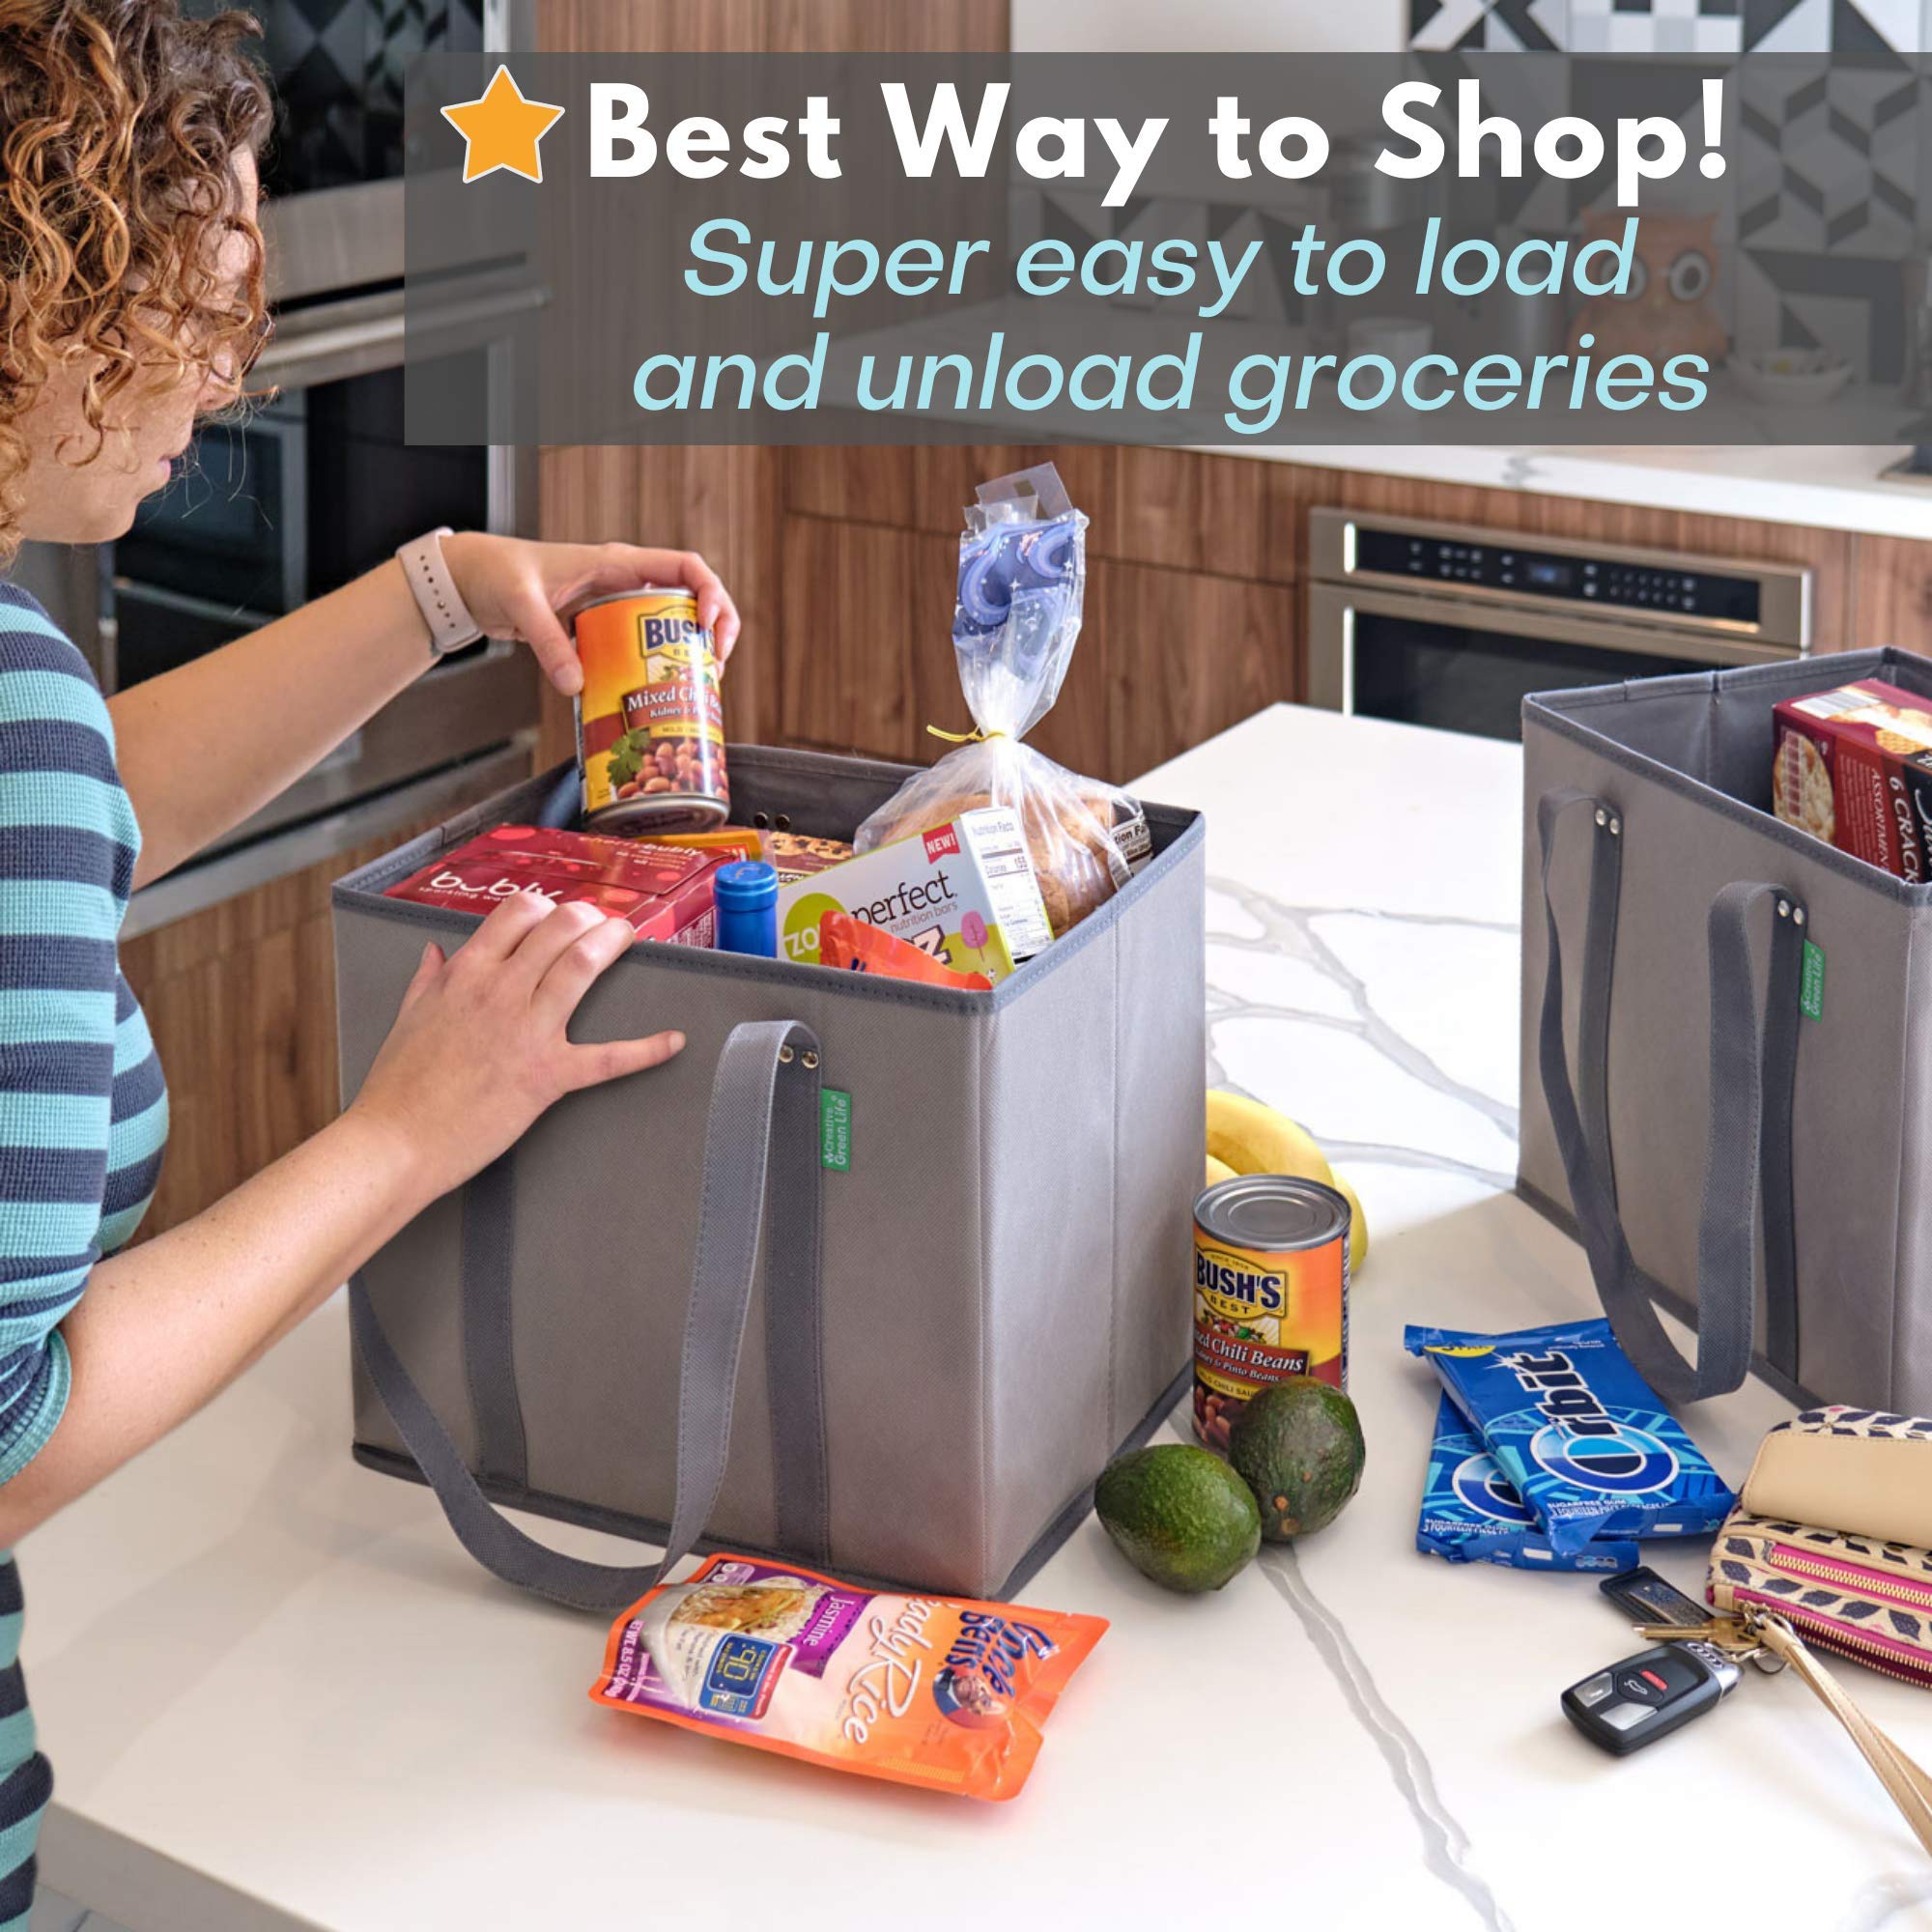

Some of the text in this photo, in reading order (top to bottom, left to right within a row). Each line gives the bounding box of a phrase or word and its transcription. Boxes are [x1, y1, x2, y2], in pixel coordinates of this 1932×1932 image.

[628, 686, 676, 711] Mixed
[1889, 776, 1905, 792] 6
[926, 834, 957, 854] NEW!
[851, 870, 954, 925] perfect
[891, 900, 958, 934] nutrition bars
[835, 1098, 847, 1166] Green Life
[1197, 1250, 1281, 1310] BUSH'S
[1210, 1294, 1252, 1315] BEST
[1211, 1338, 1249, 1362] Chili
[1250, 1350, 1304, 1372] Beans
[1223, 1361, 1248, 1377] Pinto
[1249, 1369, 1281, 1382] Beans
[1515, 1350, 1680, 1494] Orbit
[803, 1596, 855, 1646] Jasmine
[945, 1610, 1007, 1669] Ben's
[617, 1662, 632, 1678] OZ
[724, 1648, 757, 1681] 90
[981, 1621, 1062, 1698] Uncle
[843, 1650, 922, 1745] Rice
